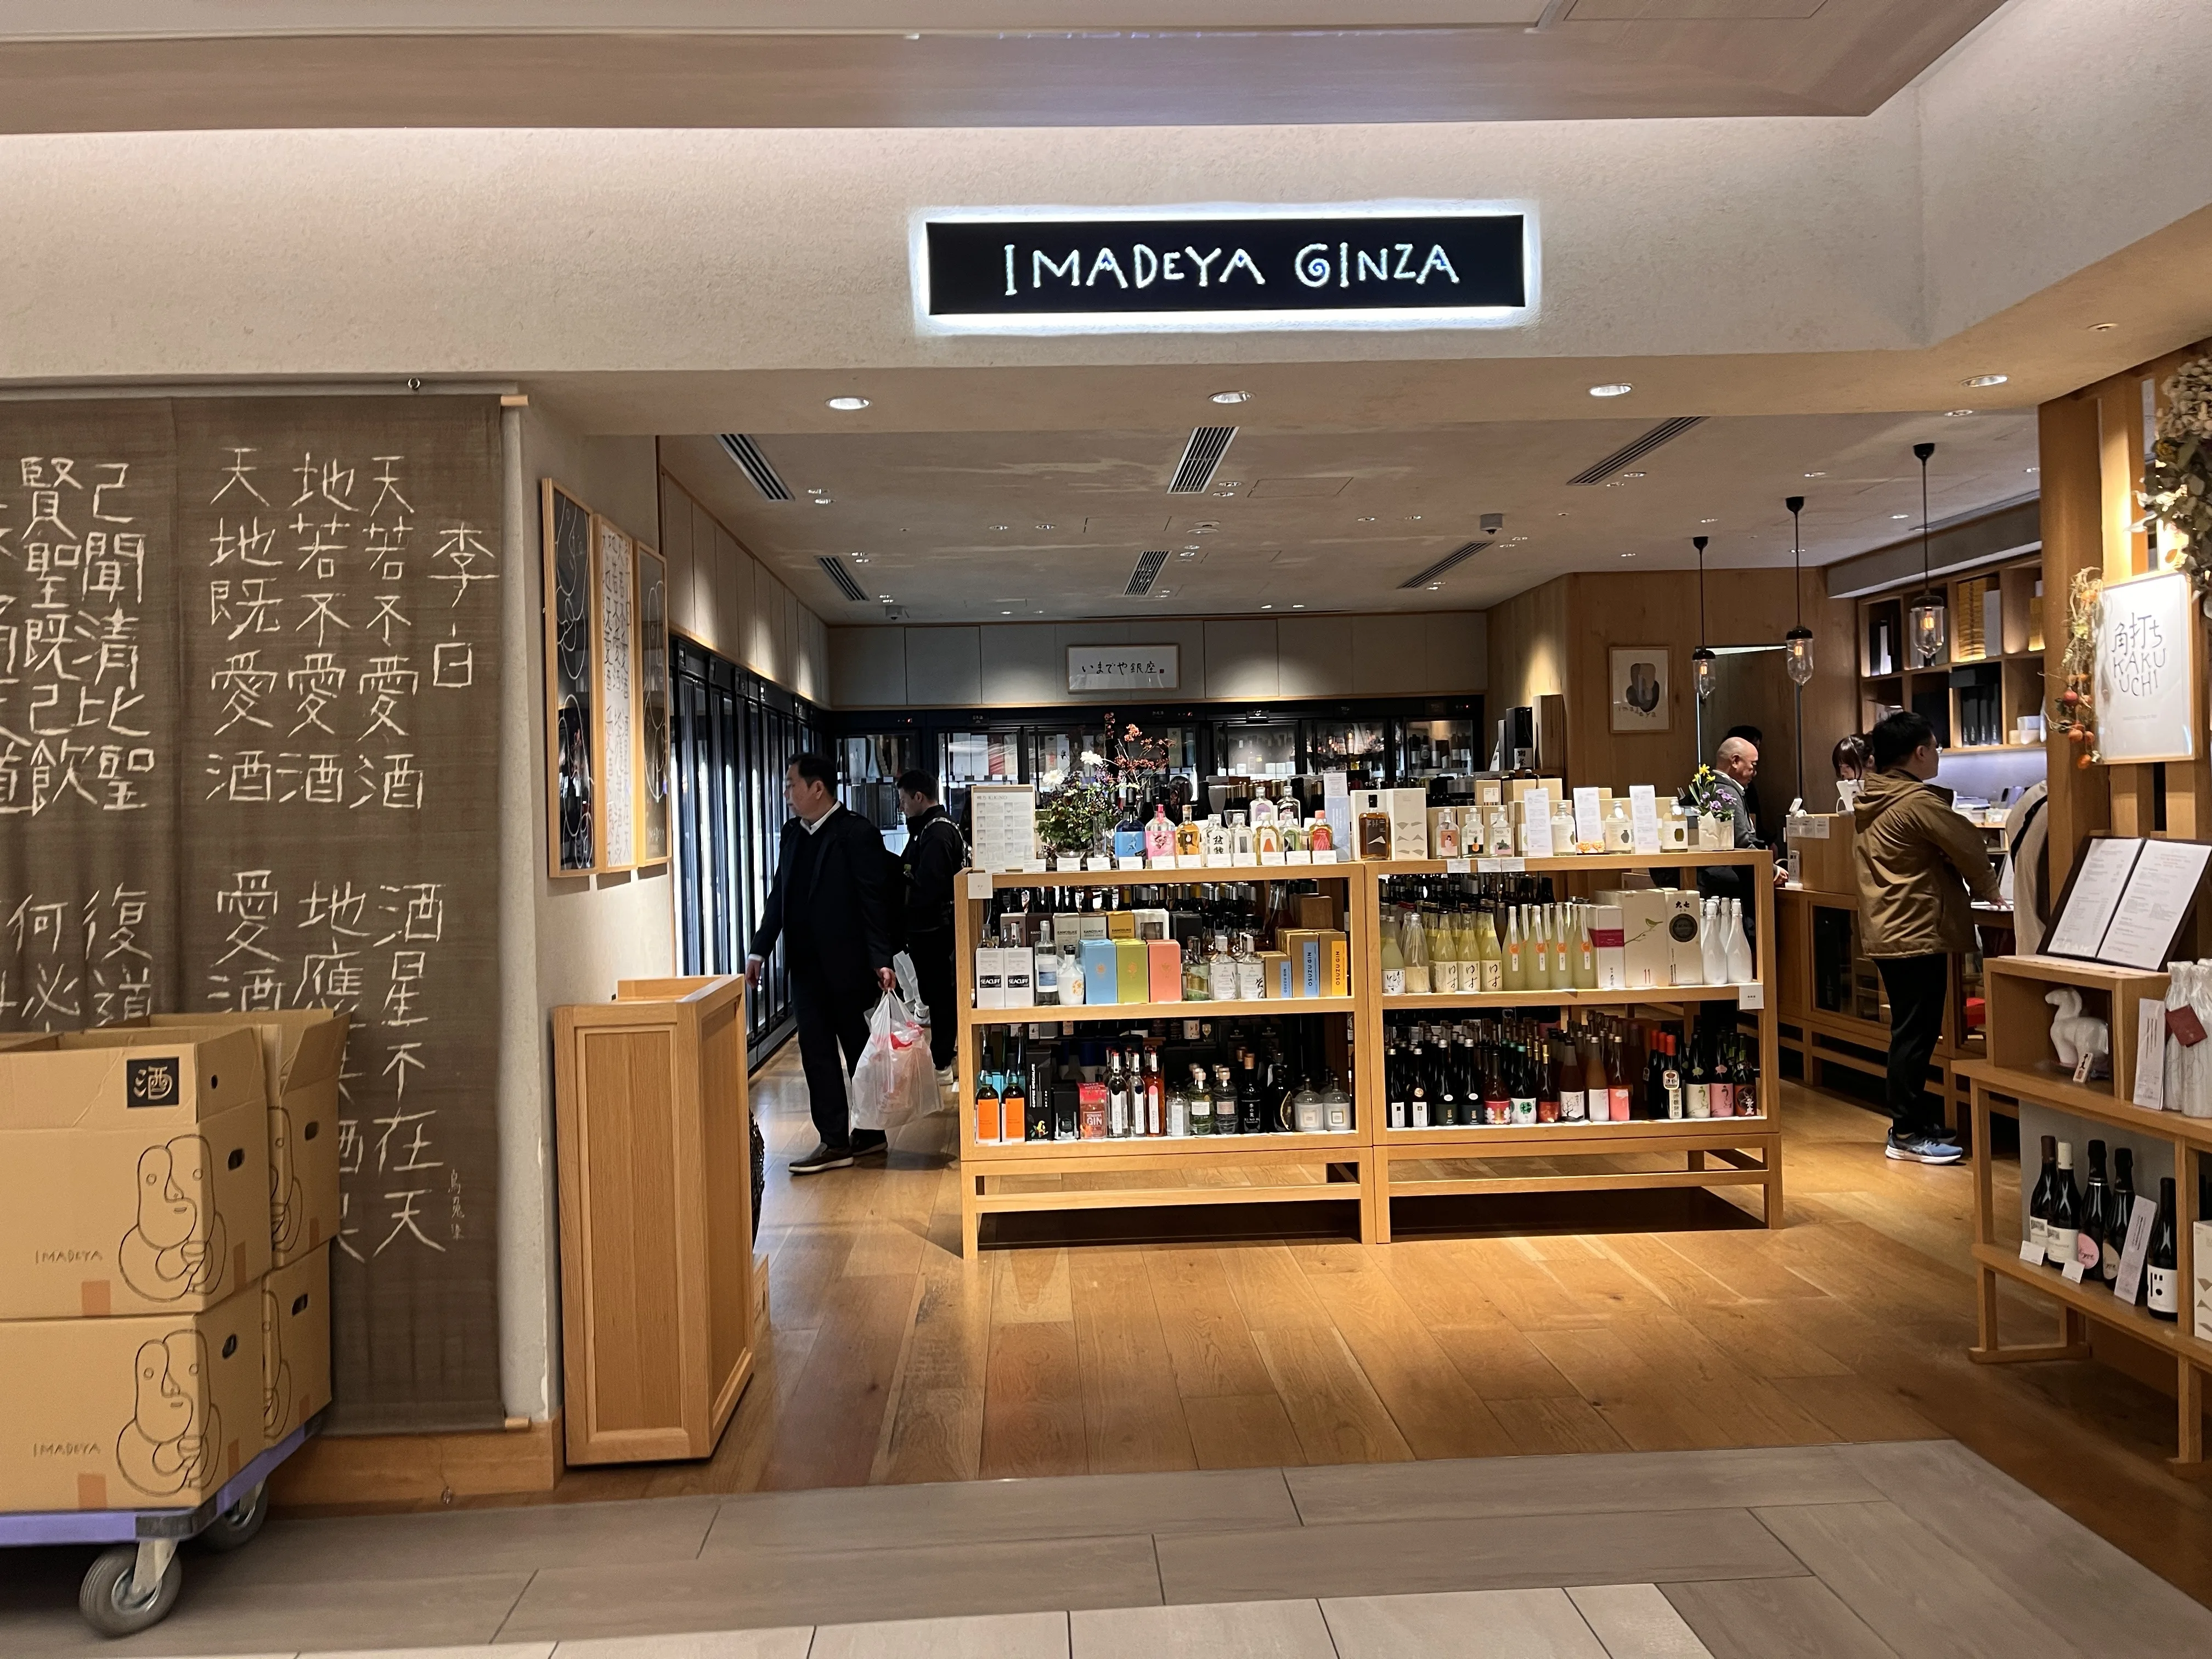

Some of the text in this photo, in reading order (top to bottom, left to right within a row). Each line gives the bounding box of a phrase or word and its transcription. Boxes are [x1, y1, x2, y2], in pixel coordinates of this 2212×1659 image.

[1004, 242, 1459, 296] IMADEYA GINZA
[2111, 612, 2164, 656] 角打ち
[1081, 661, 1158, 675] いまでや銀座
[2113, 647, 2166, 679] KAKU
[2119, 670, 2159, 697] UCHI
[133, 1065, 173, 1101] 酒
[1086, 1116, 1102, 1126] GIN
[35, 1249, 103, 1263] IMADEYA
[33, 1442, 101, 1457] IMADEYA
